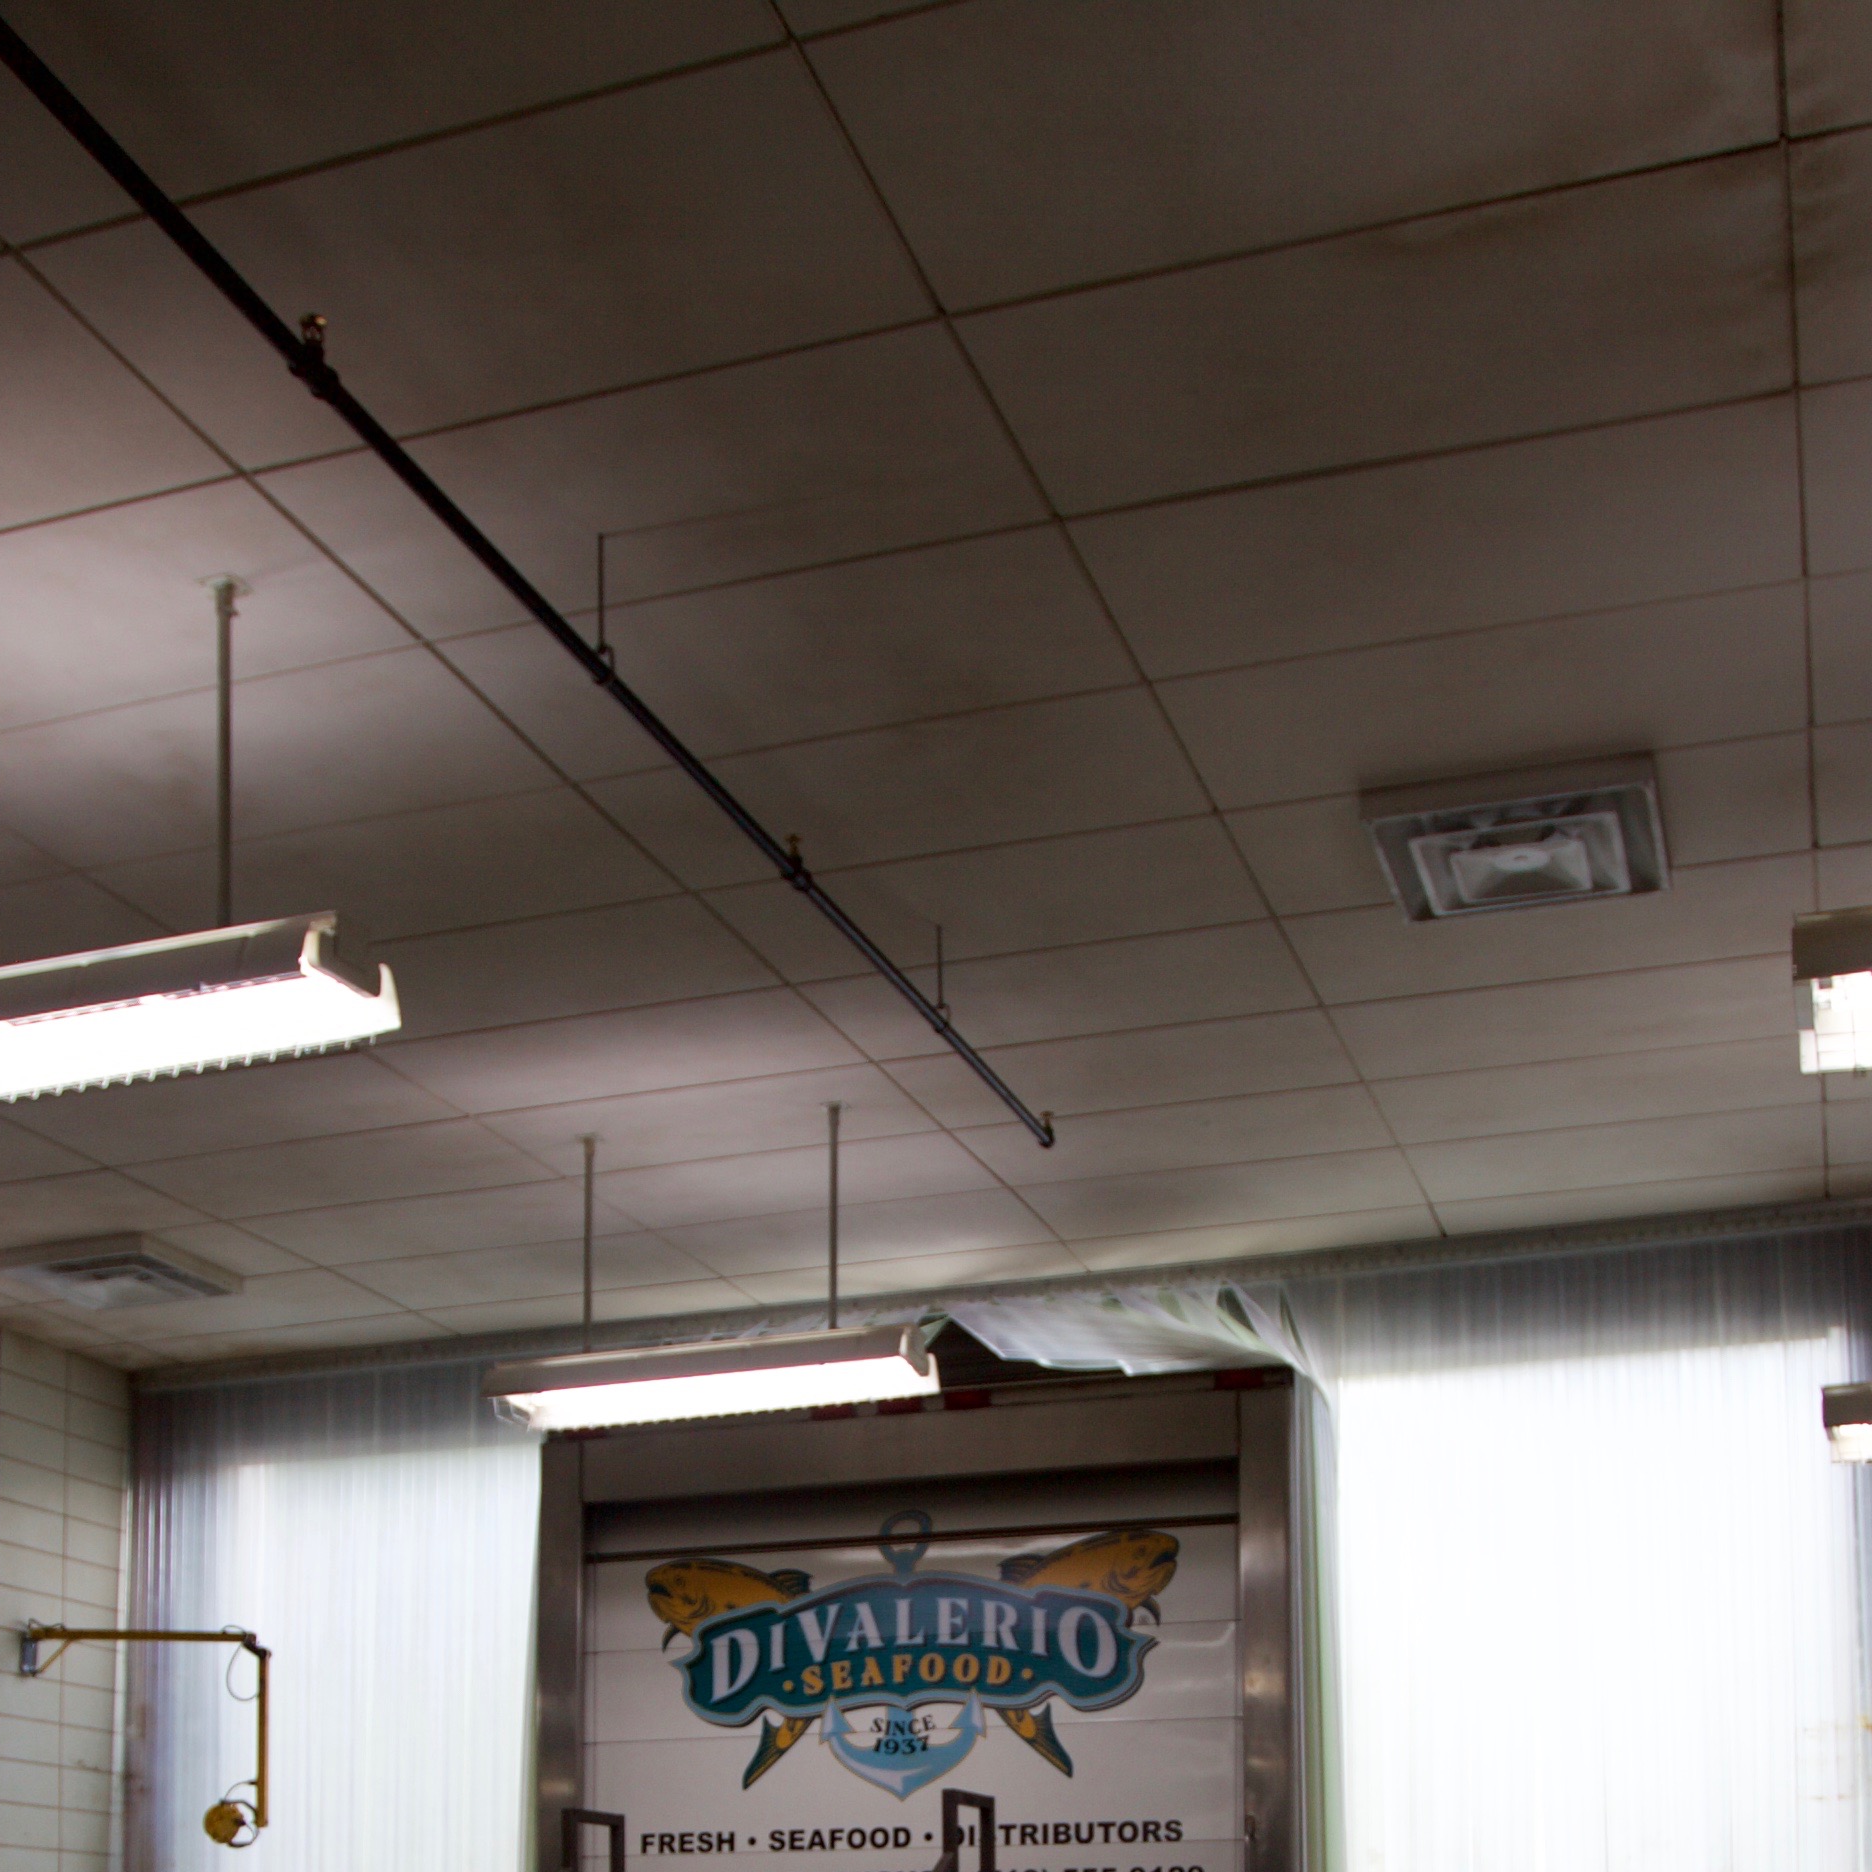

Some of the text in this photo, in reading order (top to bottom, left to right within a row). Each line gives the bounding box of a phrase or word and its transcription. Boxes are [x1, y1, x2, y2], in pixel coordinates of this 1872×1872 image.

[801, 1652, 1012, 1697] SEAFOOD
[870, 1715, 936, 1738] SINCE
[872, 1735, 928, 1756] 1937
[641, 1832, 735, 1853] FRESH
[769, 1828, 911, 1851] SEAFOOD
